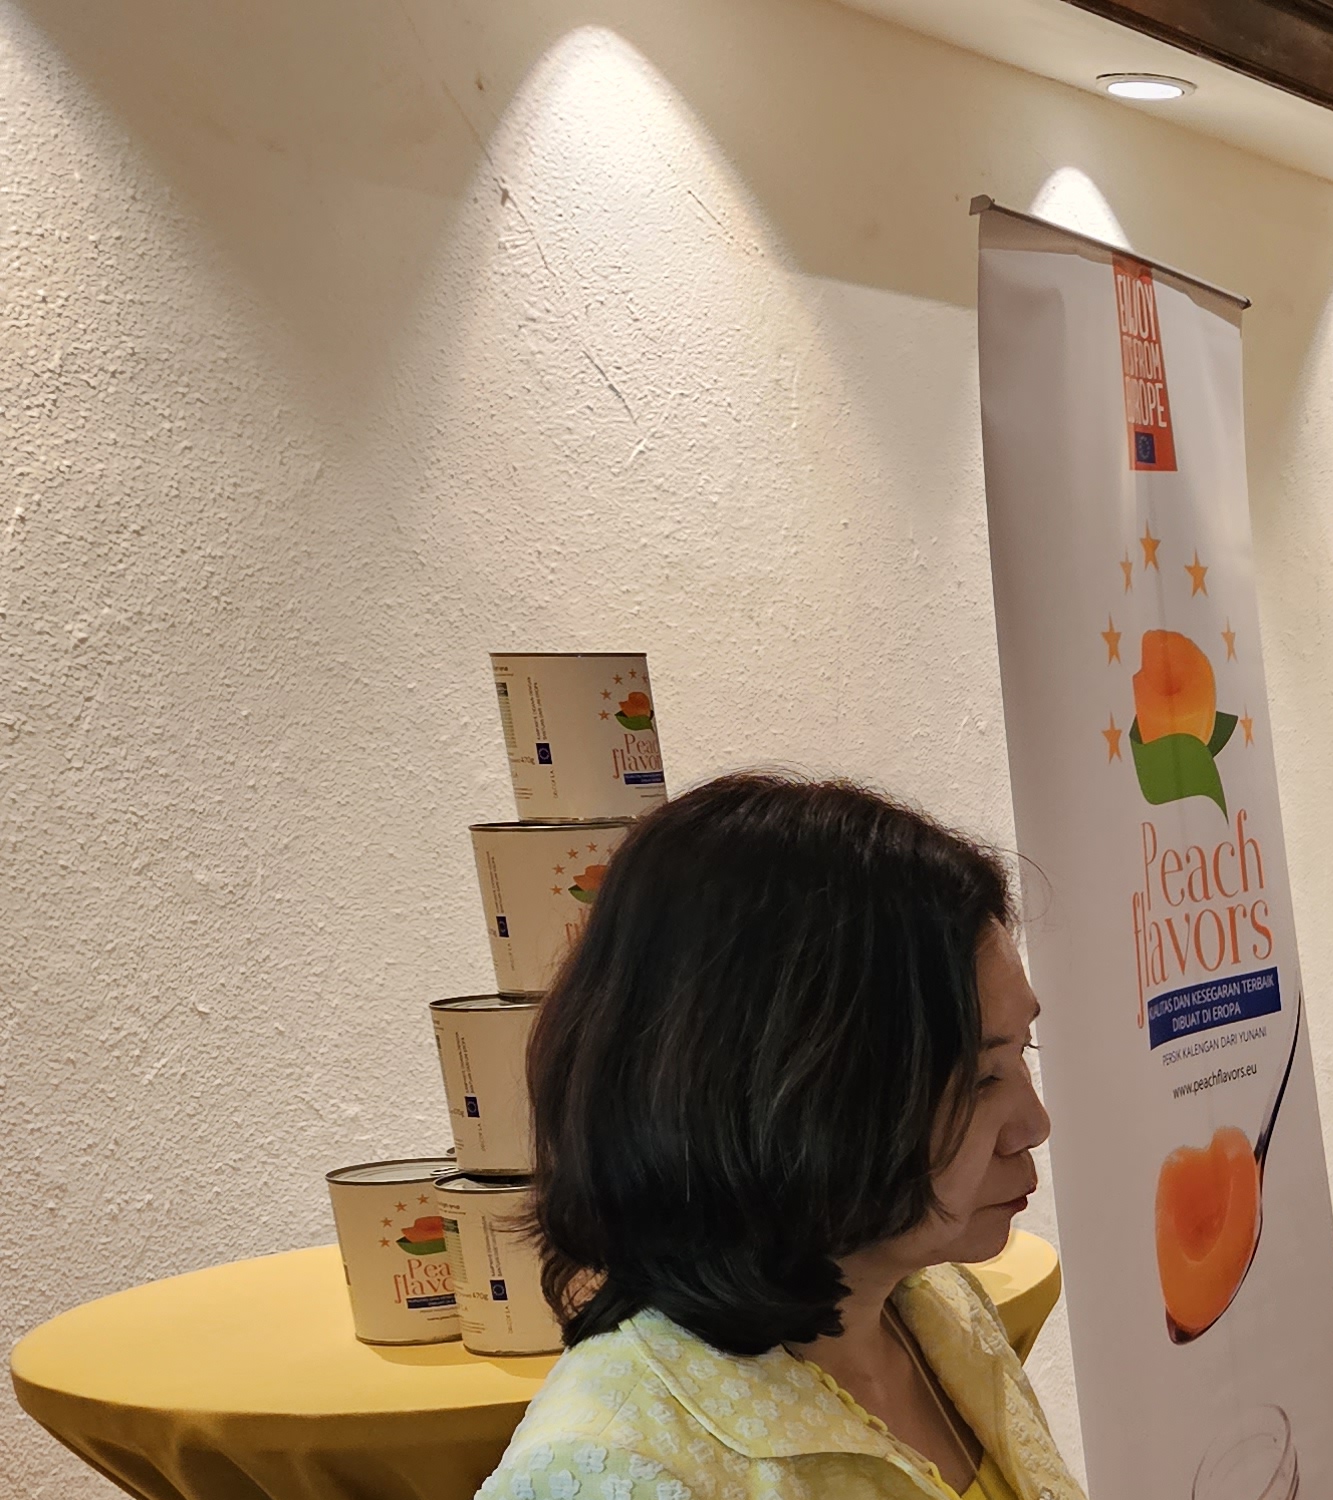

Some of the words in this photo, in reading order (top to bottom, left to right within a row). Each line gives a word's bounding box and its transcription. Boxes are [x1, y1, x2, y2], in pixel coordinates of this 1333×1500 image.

[1141, 808, 1265, 912] Peach
[1132, 889, 1274, 1030] flavors
[1149, 998, 1174, 1021] KUALITAS
[1173, 993, 1191, 1011] DAN
[1191, 984, 1242, 1006] KESEGARAN
[1241, 973, 1275, 994] TERBAIK
[1172, 1011, 1201, 1033] DIBUAT
[1202, 1008, 1212, 1024] DI
[1213, 1001, 1242, 1021] EROPA
[1162, 1048, 1183, 1066] PERSIK
[1182, 1038, 1220, 1060] KALENGAN
[1220, 1032, 1238, 1048] DARI
[1238, 1026, 1268, 1043] YUNANI
[1172, 1062, 1258, 1100] www.peachflavors.eu
